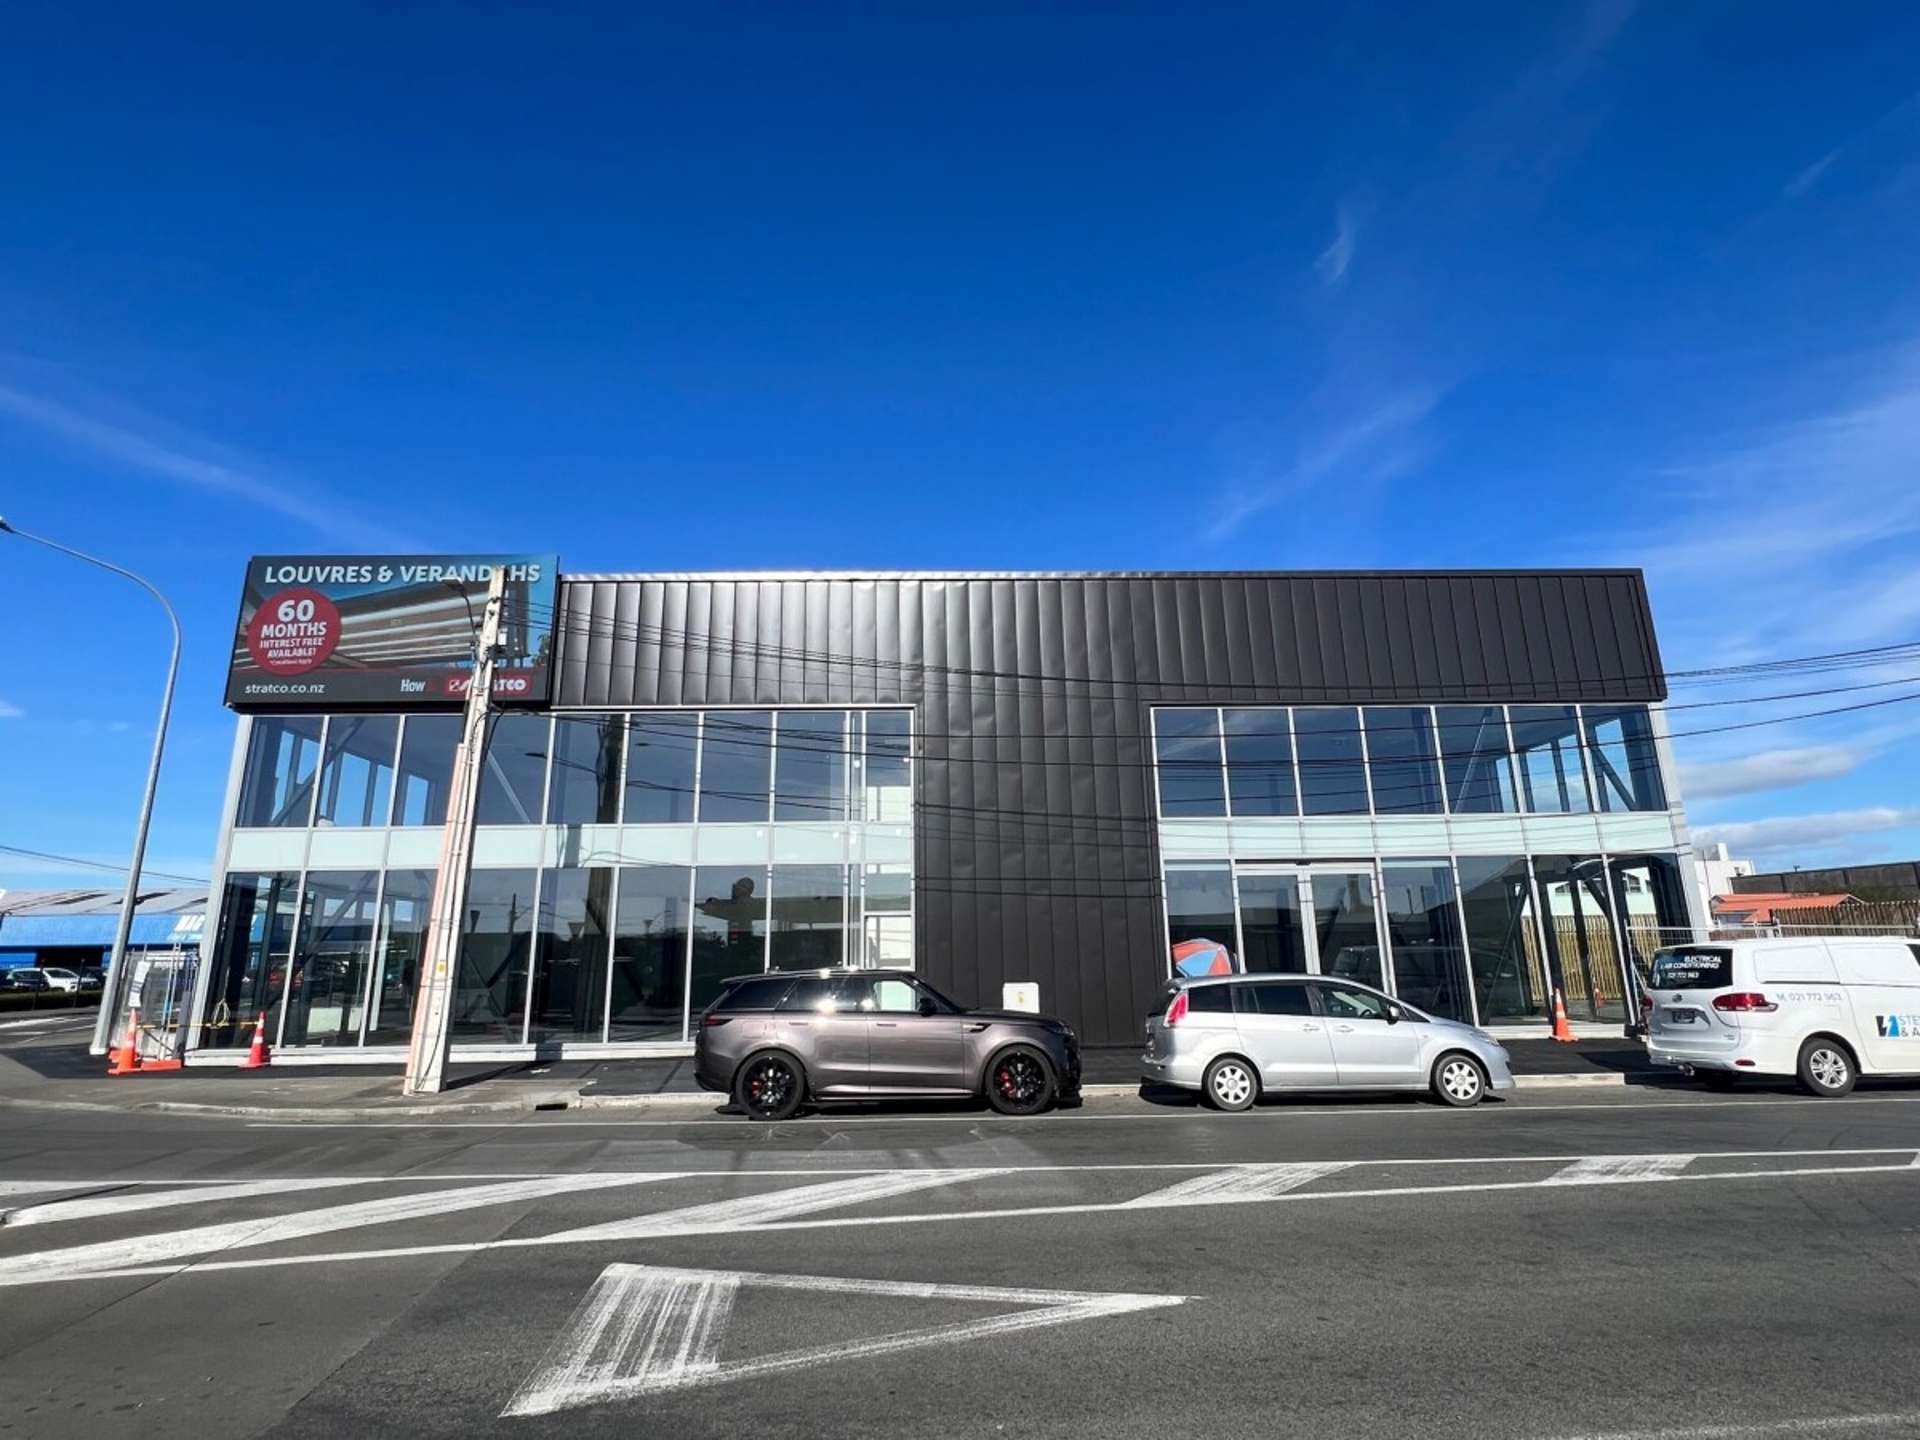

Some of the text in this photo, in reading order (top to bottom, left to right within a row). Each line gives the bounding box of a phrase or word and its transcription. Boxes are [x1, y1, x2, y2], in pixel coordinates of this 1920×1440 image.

[264, 564, 541, 583] LOUVRES & VERANDHS
[278, 599, 315, 622] 60
[261, 621, 327, 639] MONTHS
[259, 638, 301, 649] INTEREST
[267, 647, 317, 659] AVAILABLE!
[244, 683, 327, 694] stratco.co.nz
[400, 679, 426, 692] How
[1684, 955, 1722, 964] ELECTRICAL
[1673, 962, 1720, 970] CONDITIONING
[1788, 992, 1805, 1001] 021
[1806, 992, 1822, 1001] 772
